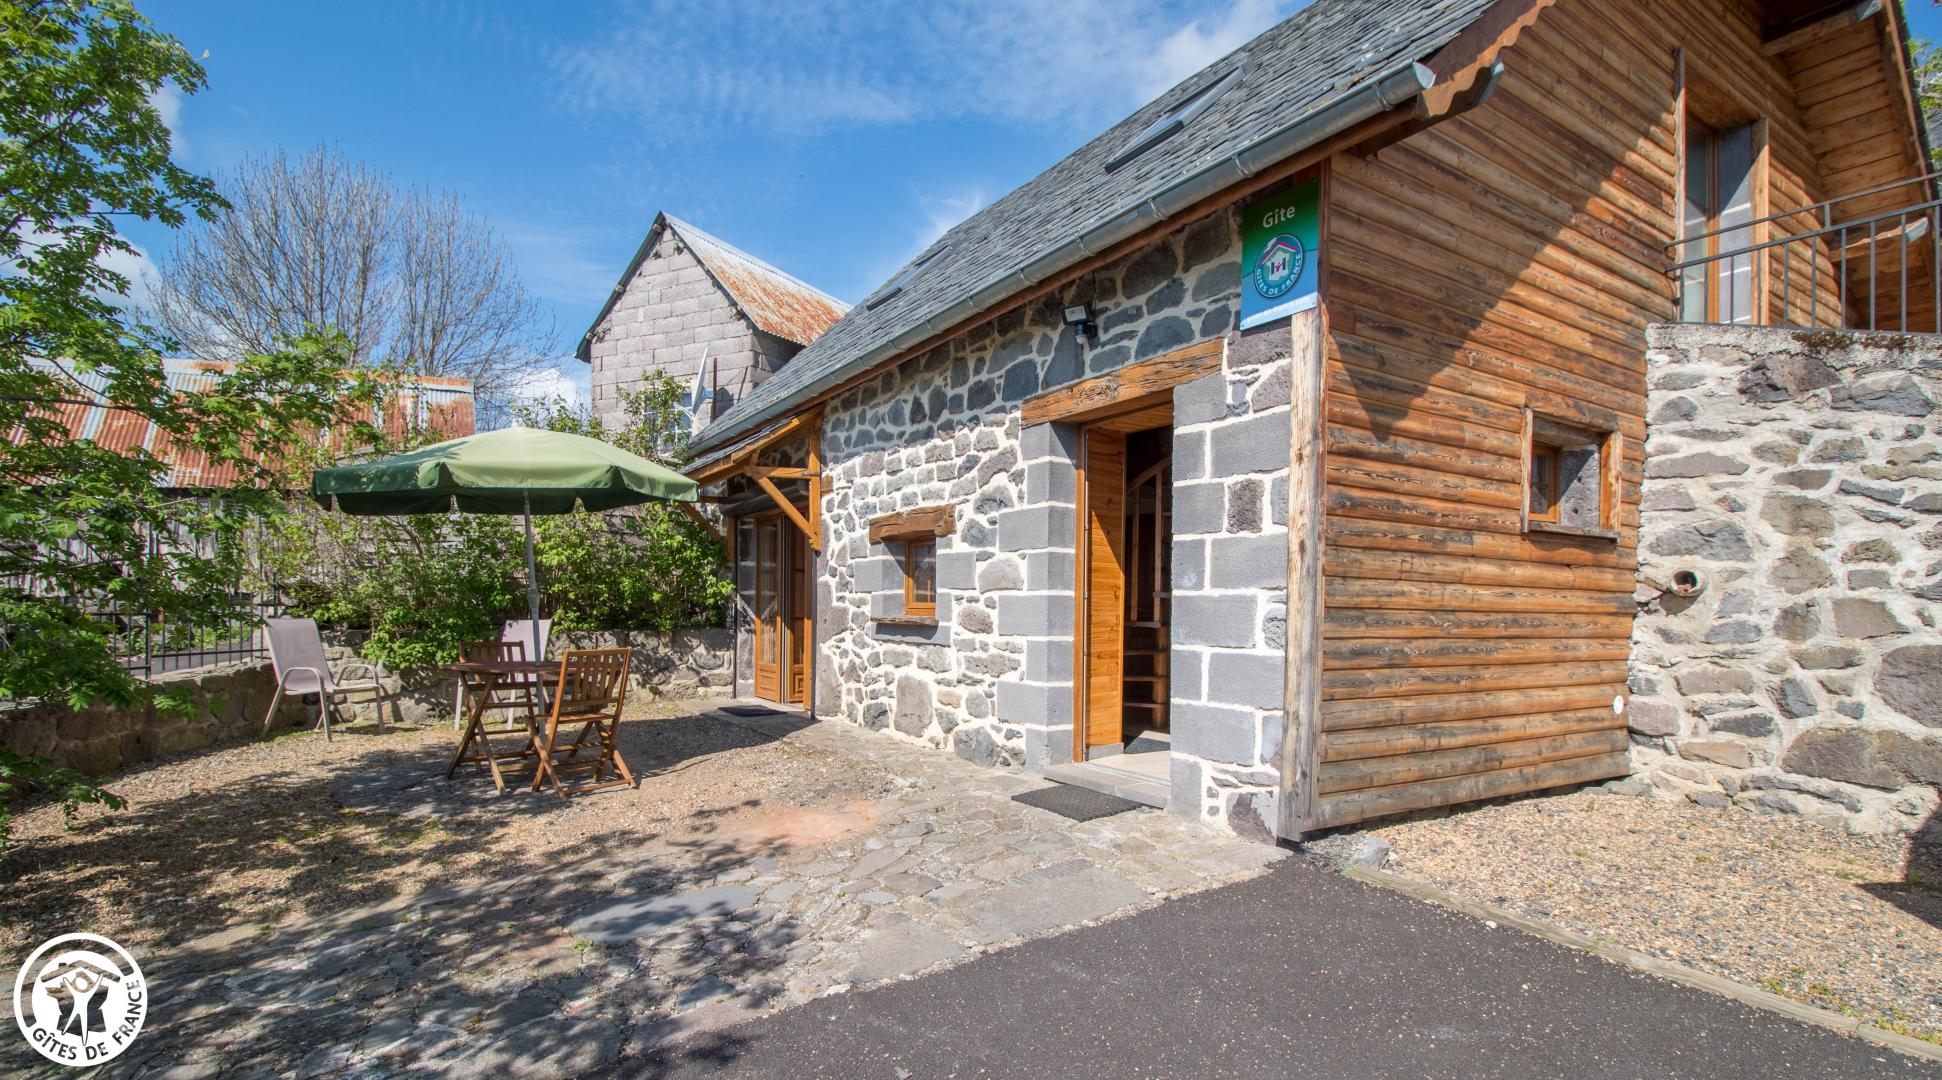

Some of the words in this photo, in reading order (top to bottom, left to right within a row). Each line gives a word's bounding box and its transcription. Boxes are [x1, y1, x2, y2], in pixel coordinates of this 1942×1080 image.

[1263, 206, 1295, 228] Gîte
[1268, 287, 1279, 295] DE
[1282, 254, 1300, 290] FRANCE
